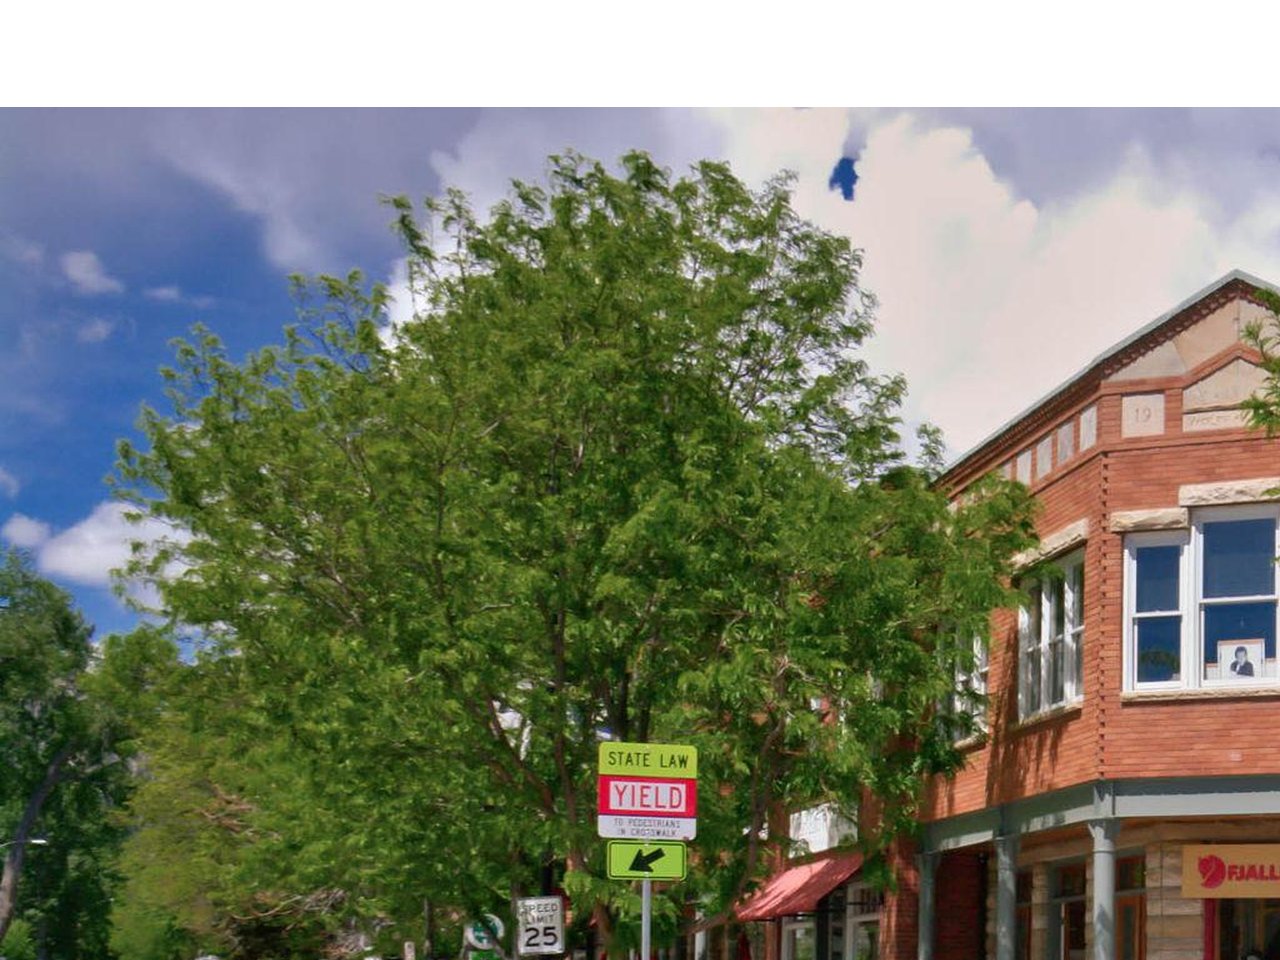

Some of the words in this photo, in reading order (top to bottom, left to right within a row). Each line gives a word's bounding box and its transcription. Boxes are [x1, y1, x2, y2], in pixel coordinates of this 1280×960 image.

[608, 751, 651, 767] STATE
[660, 753, 689, 769] LAW
[614, 784, 682, 809] YIELD
[520, 903, 559, 914] SPEED
[525, 914, 555, 925] LIMIT
[524, 926, 559, 947] 25
